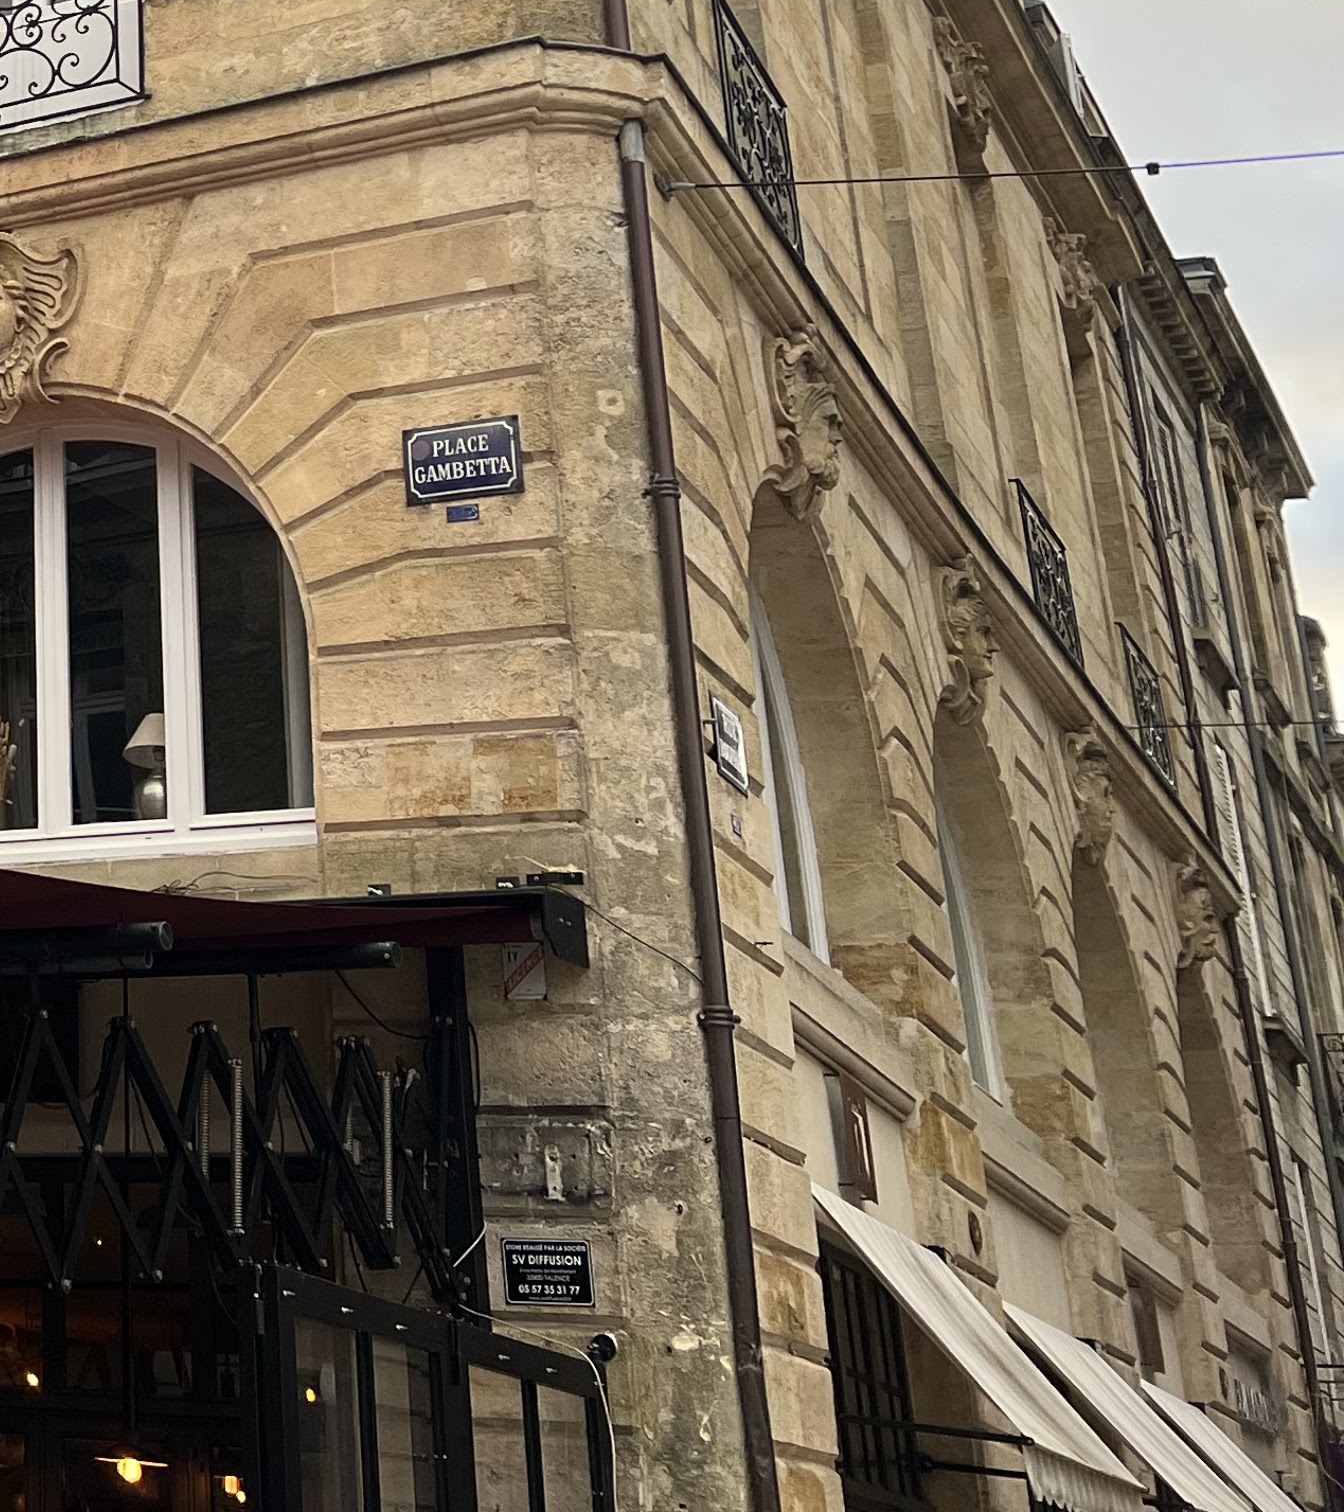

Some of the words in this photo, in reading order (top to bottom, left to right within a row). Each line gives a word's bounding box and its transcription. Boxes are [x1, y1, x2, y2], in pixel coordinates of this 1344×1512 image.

[433, 434, 489, 457] PLACE
[415, 456, 512, 484] GAMBETTA
[512, 1254, 525, 1265] SV
[527, 1254, 582, 1266] DIFFUSION
[518, 1284, 530, 1294] 05
[531, 1284, 542, 1294] 57
[544, 1285, 555, 1295] 35
[556, 1285, 567, 1295] 31
[569, 1285, 581, 1296] 77
